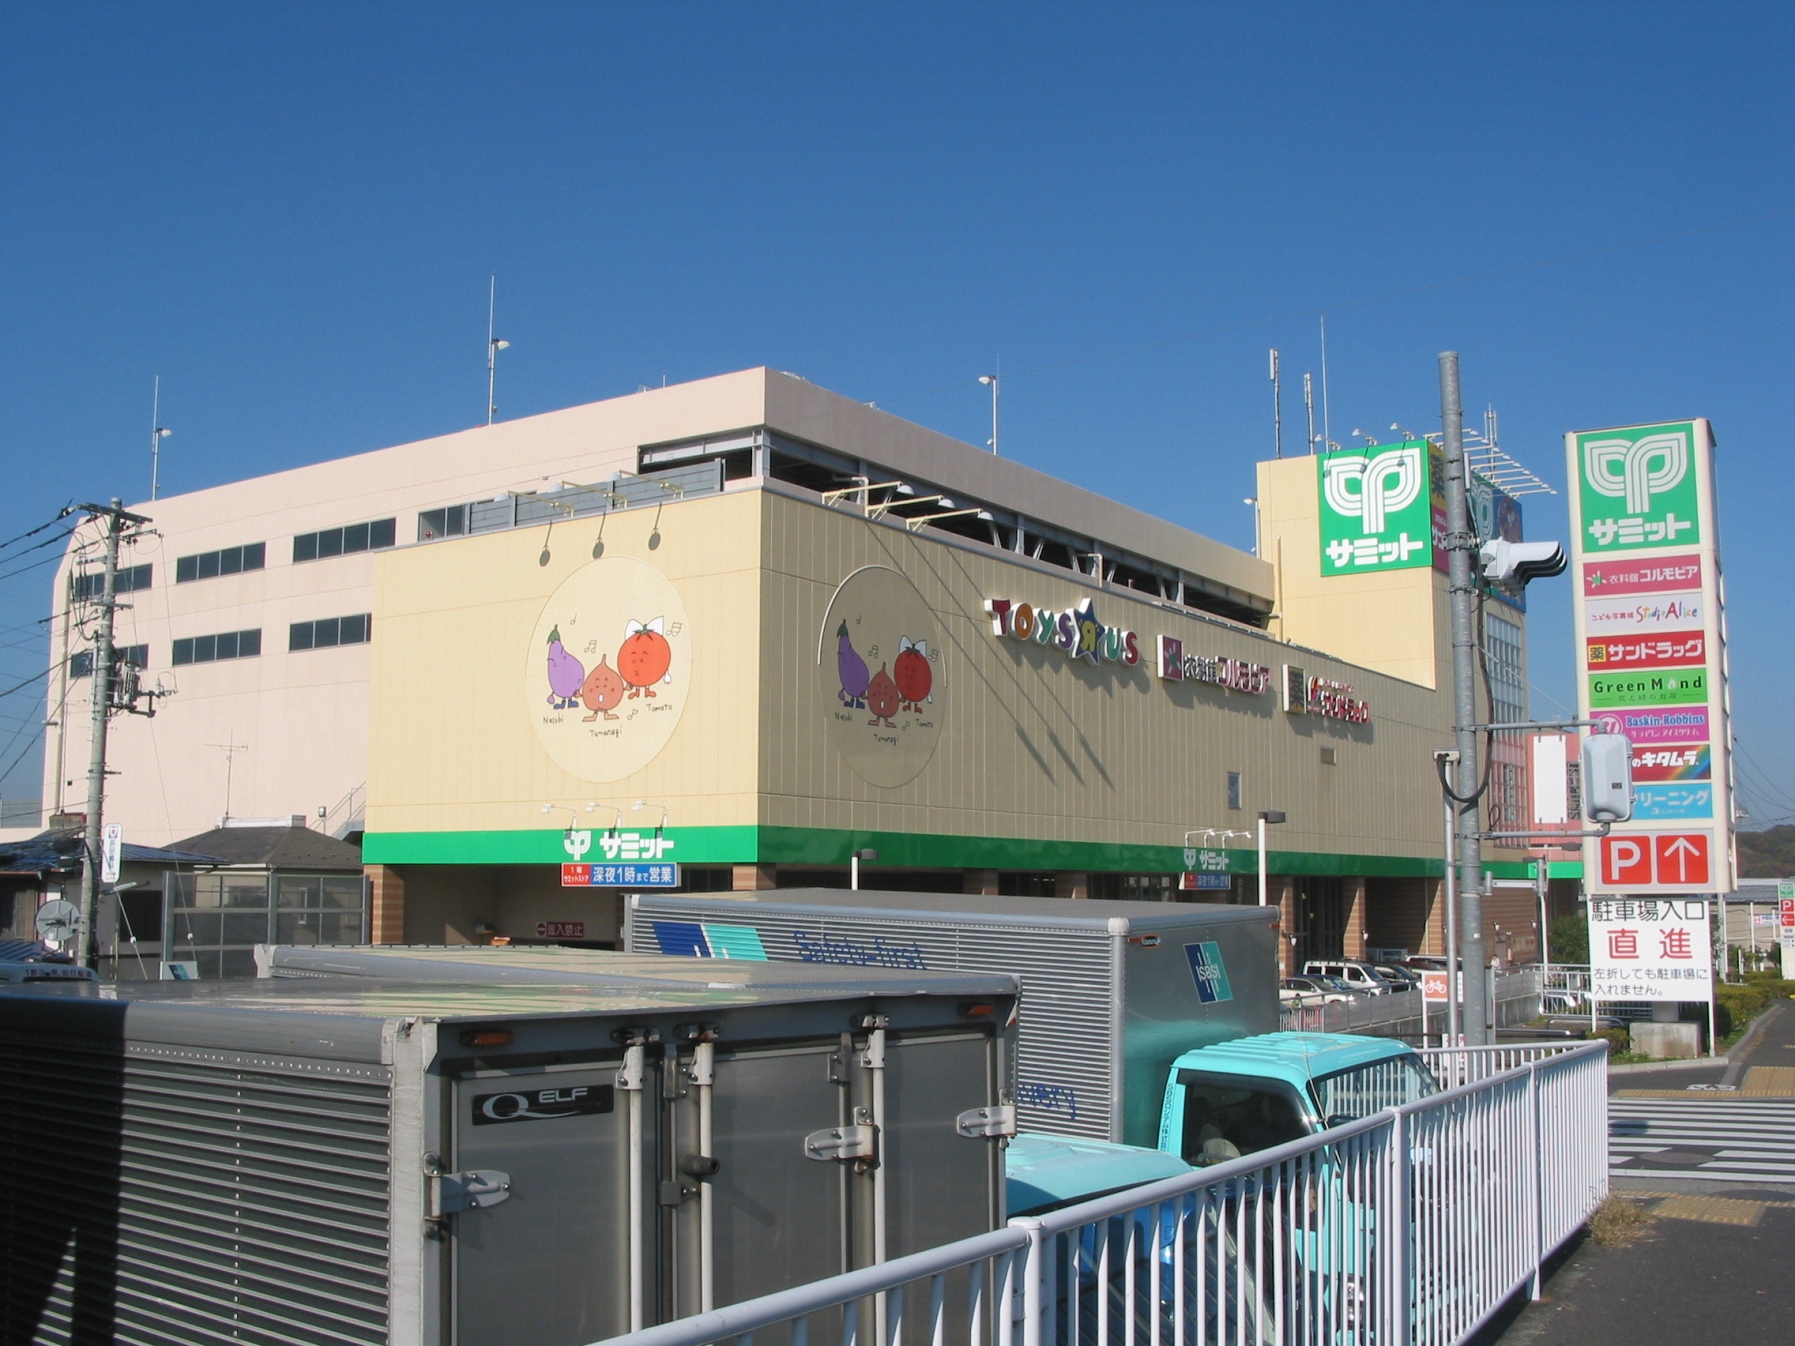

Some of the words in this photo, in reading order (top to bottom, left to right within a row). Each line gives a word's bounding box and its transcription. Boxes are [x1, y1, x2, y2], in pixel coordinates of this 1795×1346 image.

[1588, 513, 1691, 545] サミット
[1326, 533, 1423, 567] サミット
[986, 599, 1075, 650] TOYS
[1104, 627, 1139, 666] US
[1608, 639, 1702, 661] サンドラッグ
[1594, 681, 1645, 693] Green
[646, 703, 673, 712] Tomato
[599, 831, 674, 859] サミット
[1199, 850, 1229, 870] サミット
[1610, 840, 1642, 881] P
[593, 866, 672, 882] 深夜1時まで営業
[1592, 901, 1705, 921] 駐車場入口
[1783, 901, 1792, 911] P
[1607, 928, 1693, 959] 直進
[1594, 968, 1708, 980] 左折しても駐車場に
[1595, 984, 1663, 996] 入れません。
[539, 1087, 588, 1103] ELF
